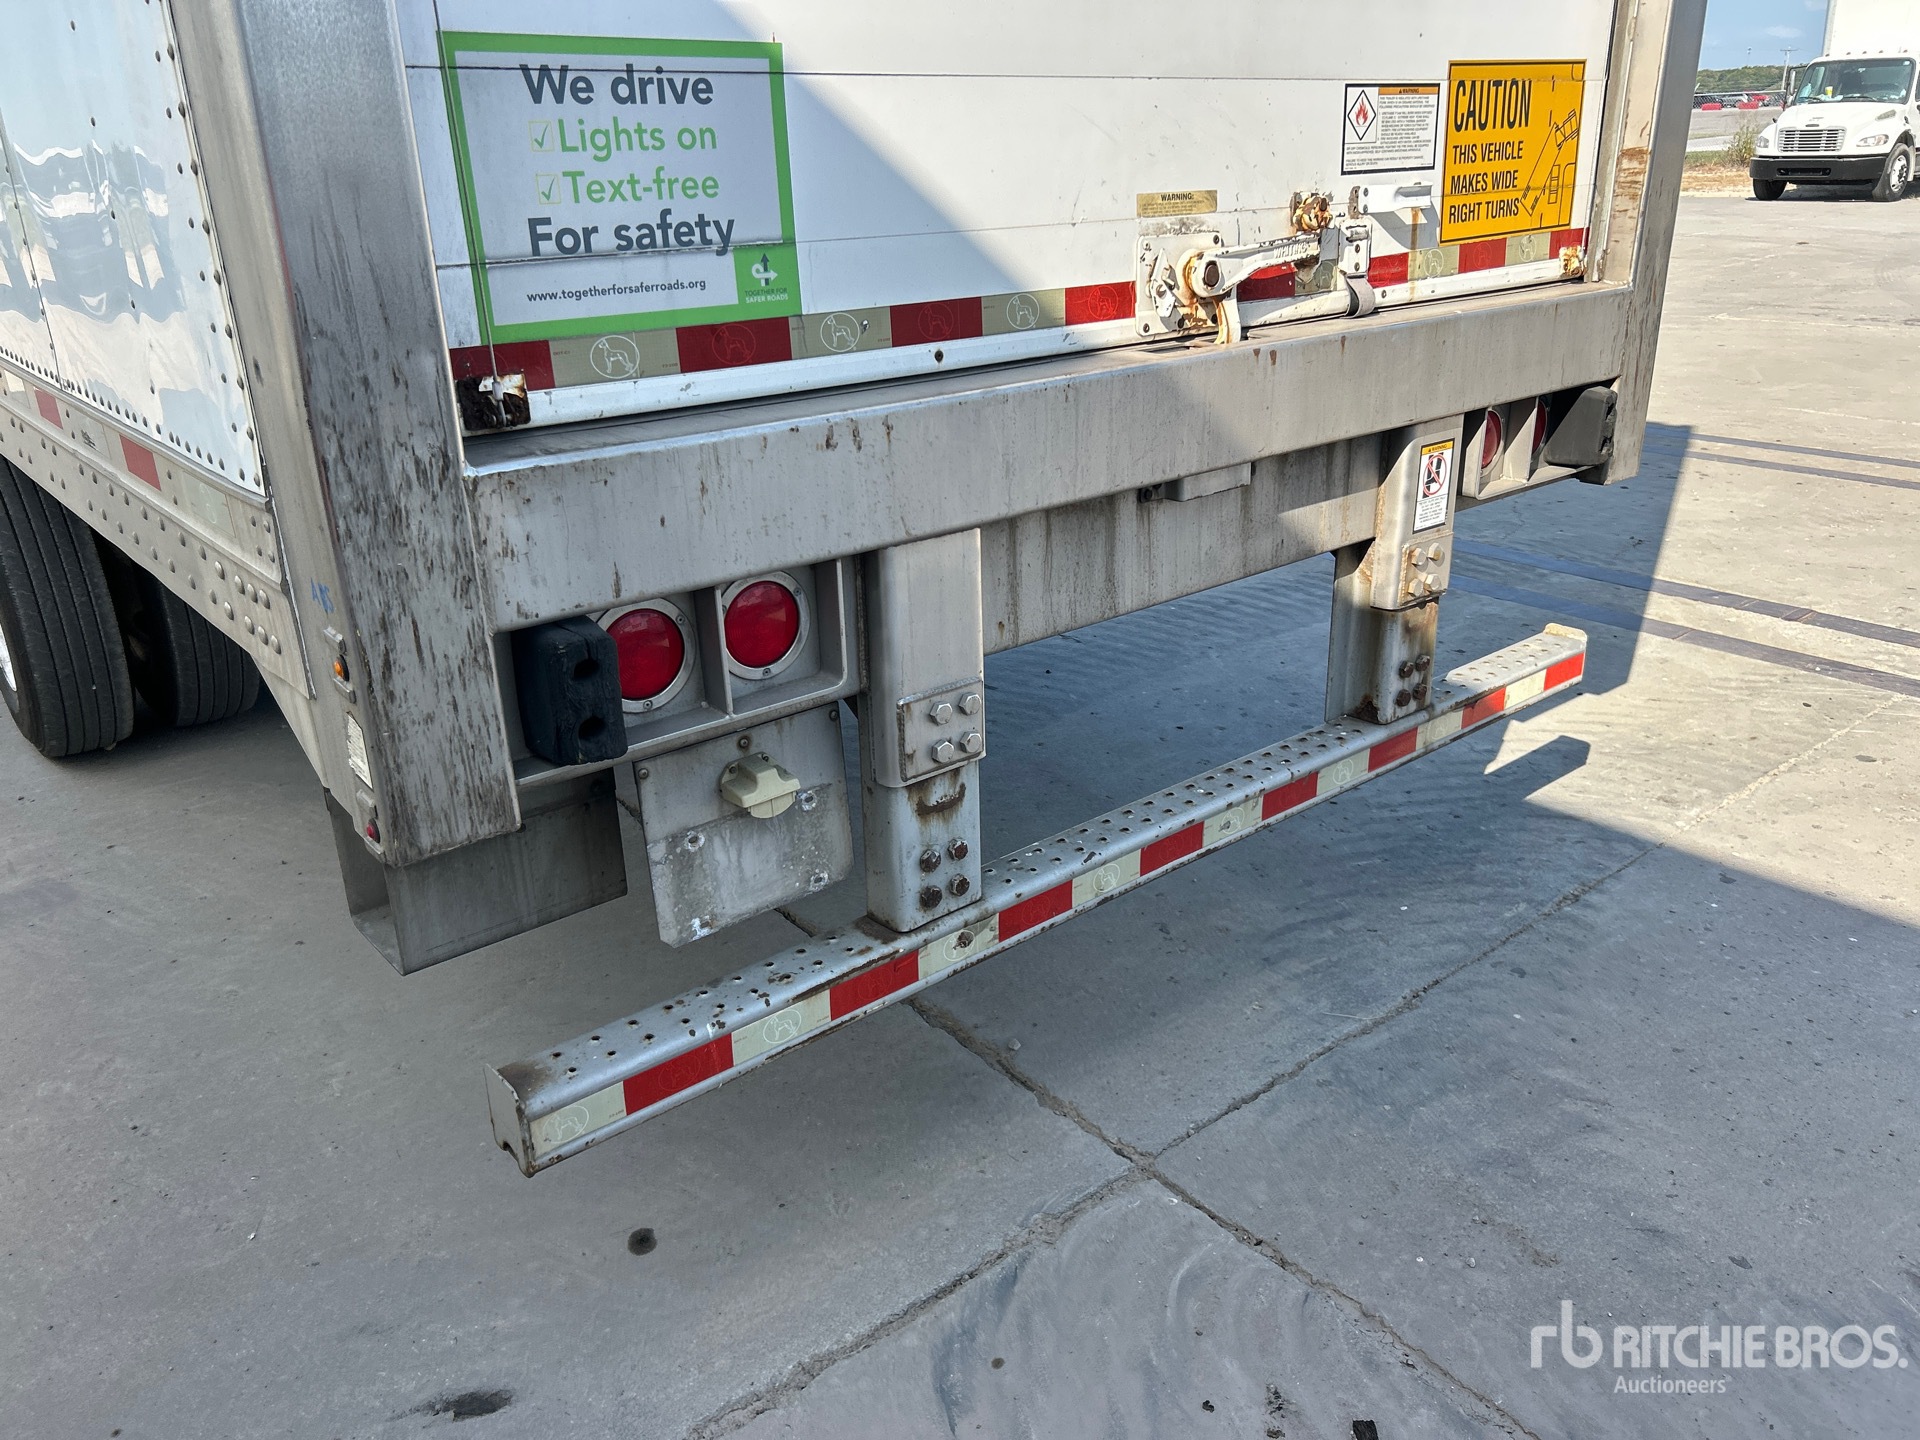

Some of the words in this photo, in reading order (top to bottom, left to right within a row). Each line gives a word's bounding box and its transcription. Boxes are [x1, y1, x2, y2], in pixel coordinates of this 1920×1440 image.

[519, 63, 595, 105] We
[610, 63, 714, 105] drive
[1454, 78, 1532, 133] CAUTION
[558, 116, 666, 162] Lights
[677, 126, 717, 149] on
[1452, 143, 1477, 165] THIS
[1480, 140, 1523, 162] VEHICLE
[562, 166, 720, 204] Text-free
[1450, 172, 1488, 195] MAKES
[1491, 169, 1519, 191] WIDE
[1449, 202, 1483, 224] RIGHT
[1485, 198, 1520, 220] TURNS
[527, 216, 599, 257] For
[613, 208, 735, 256] safety
[527, 278, 707, 302] www.togetherforsaferroads.org
[745, 288, 775, 296] TOGETHER
[745, 295, 766, 304] SAFER
[767, 293, 789, 302] ROADS
